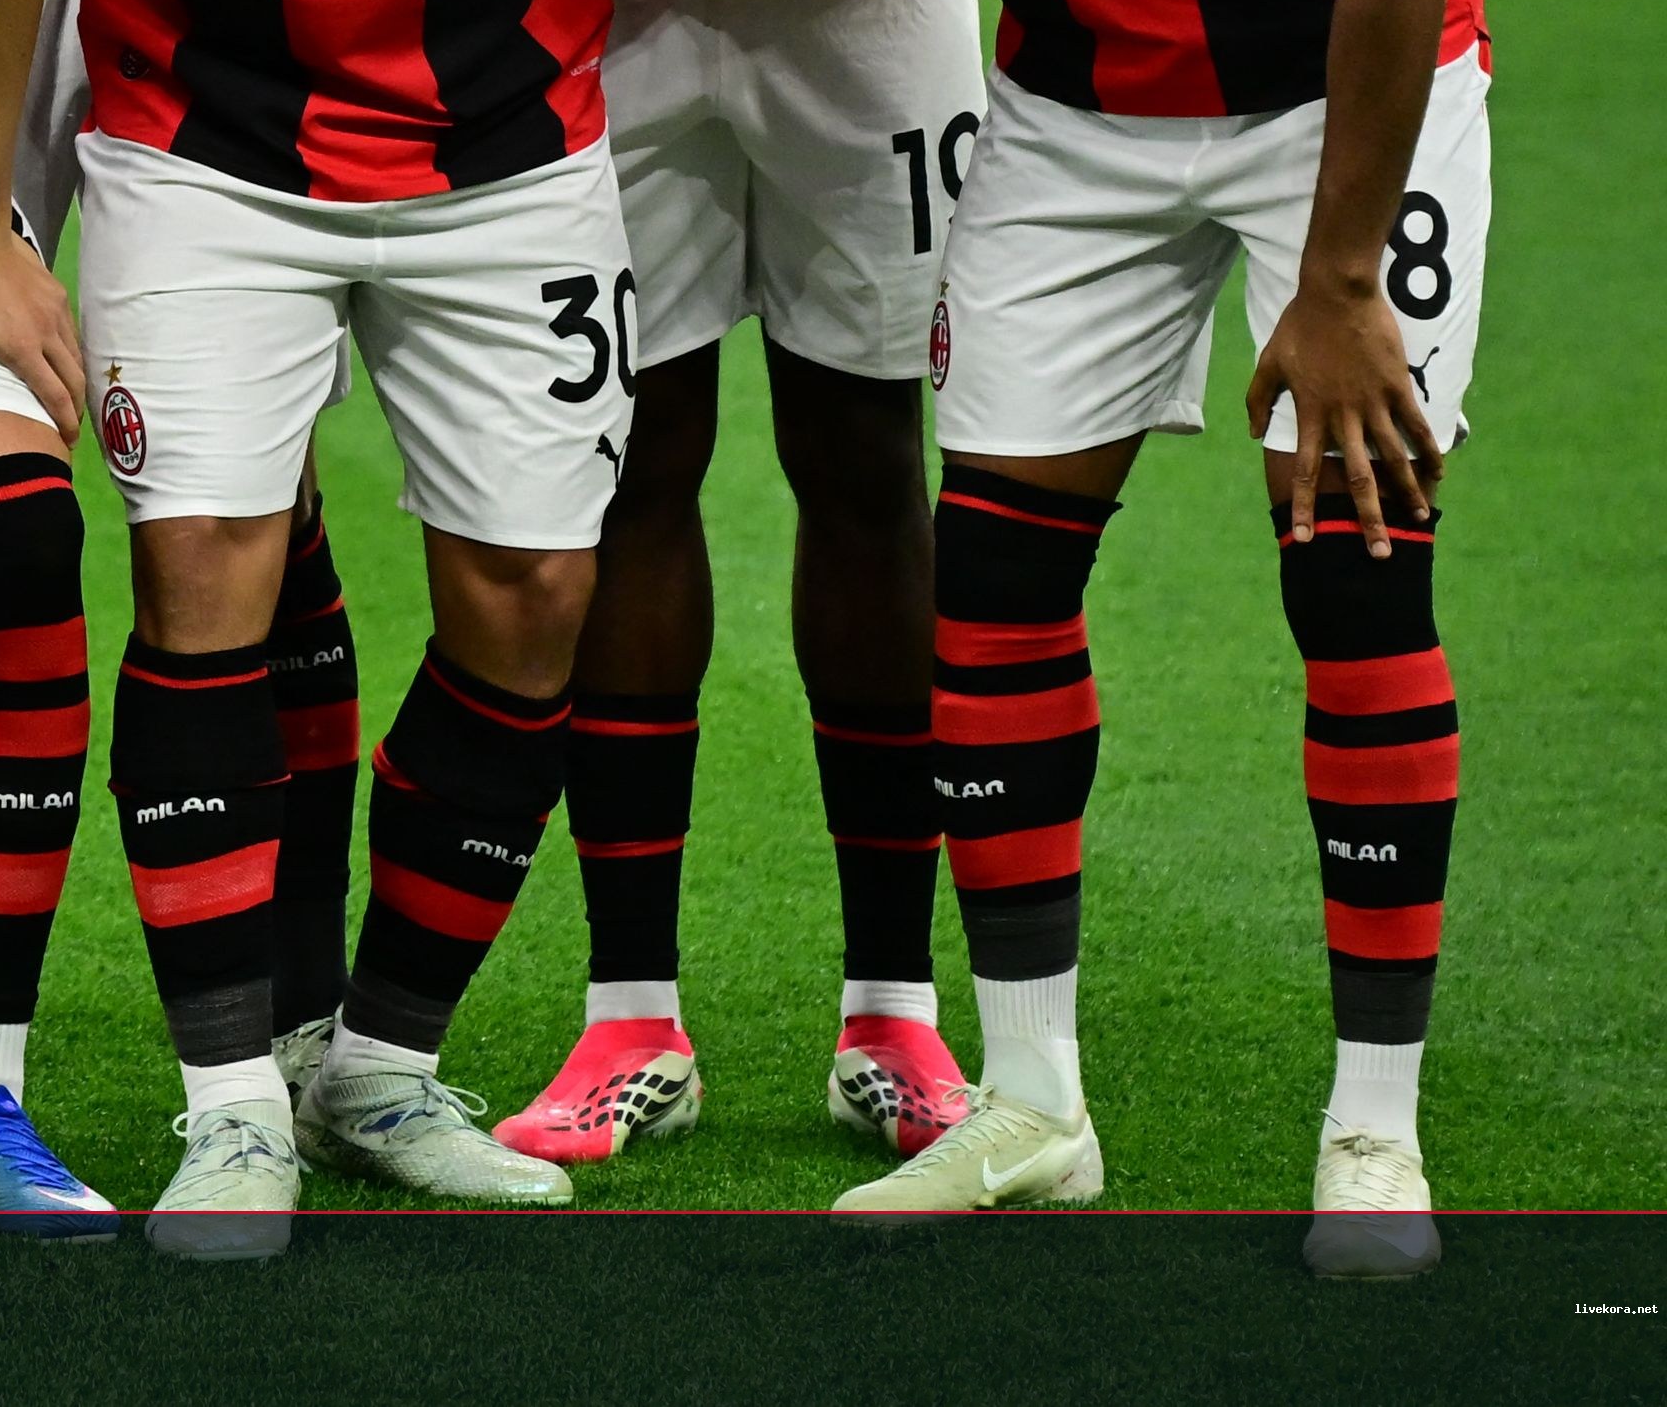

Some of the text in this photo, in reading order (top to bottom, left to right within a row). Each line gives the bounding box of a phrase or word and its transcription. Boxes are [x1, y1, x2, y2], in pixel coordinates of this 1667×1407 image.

[541, 266, 637, 404] 30
[137, 797, 225, 824] MILAN
[462, 837, 535, 869] MILA
[1327, 838, 1398, 863] MILAN
